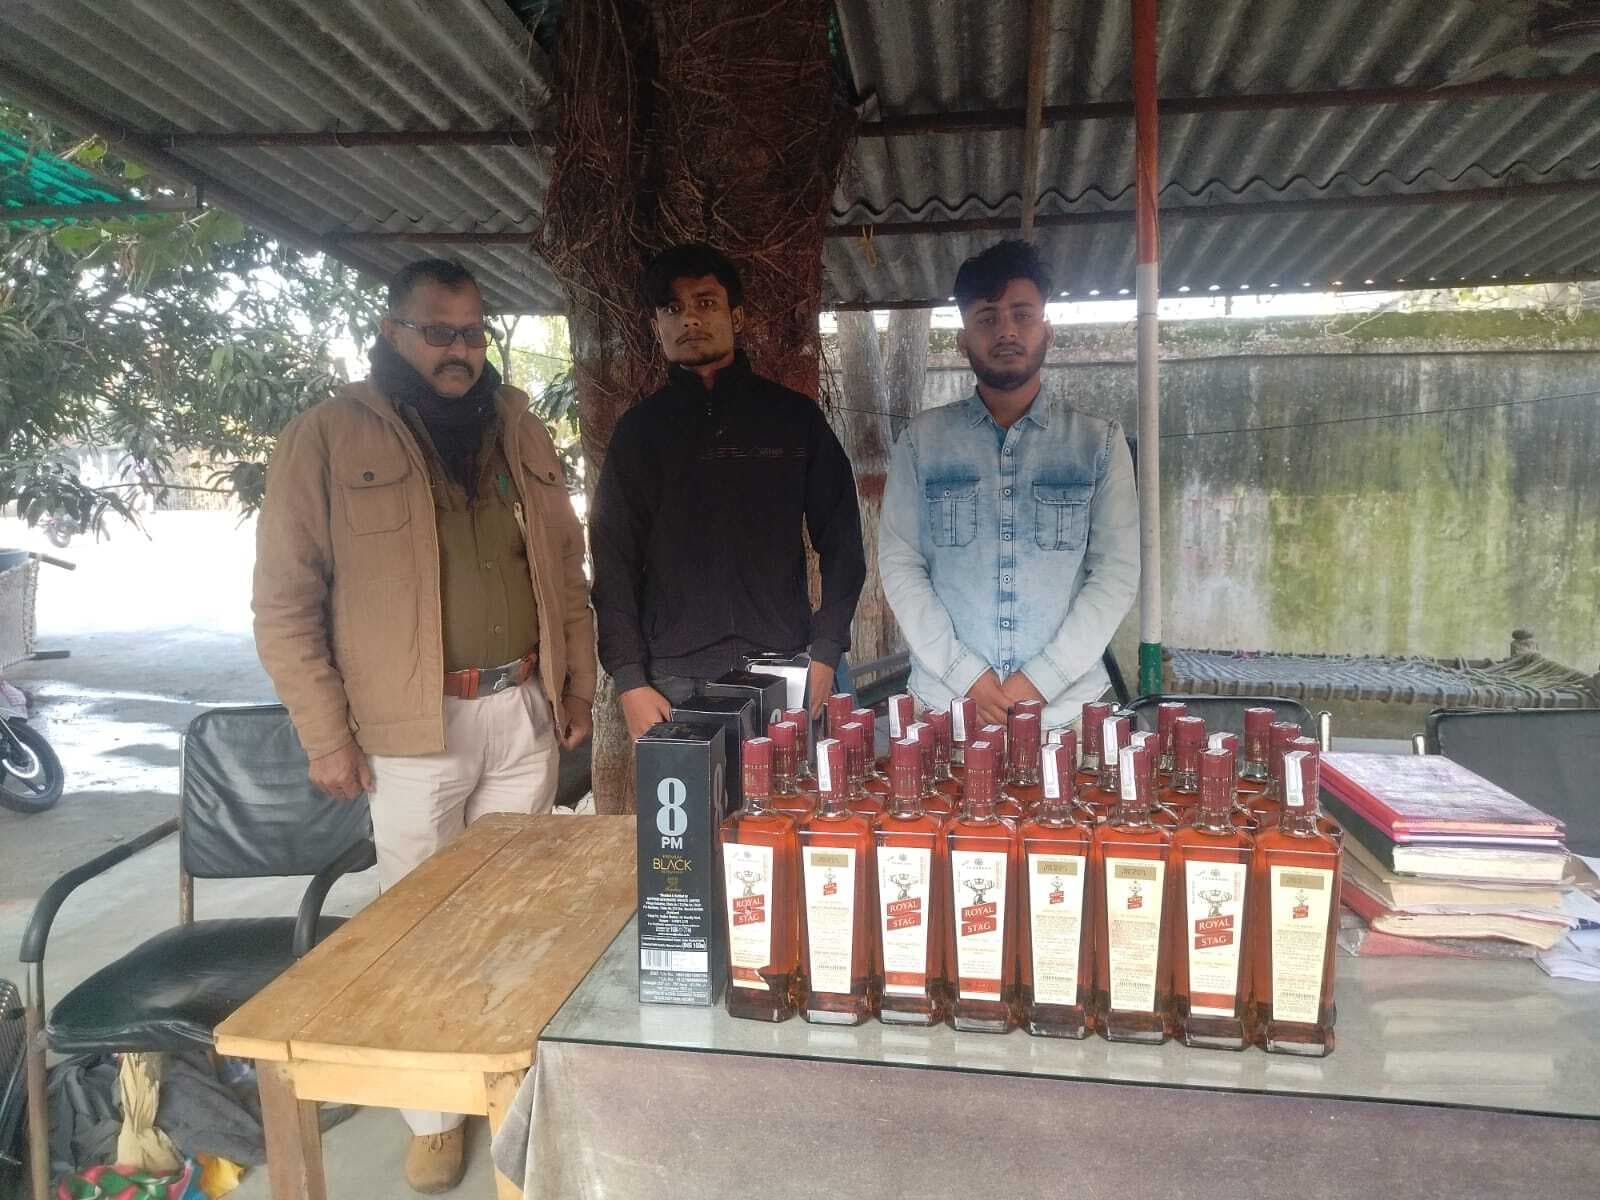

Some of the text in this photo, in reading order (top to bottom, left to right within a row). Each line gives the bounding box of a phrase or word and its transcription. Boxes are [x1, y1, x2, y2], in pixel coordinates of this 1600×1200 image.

[656, 777, 688, 837] 8
[661, 836, 683, 850] PM
[653, 857, 693, 872] BLACK
[889, 900, 918, 913] ROYAL
[965, 905, 995, 917] ROYAL
[891, 917, 916, 928] STAG
[966, 921, 992, 933] STAG
[1199, 917, 1230, 930] ROYAL
[1200, 935, 1227, 946] STAG
